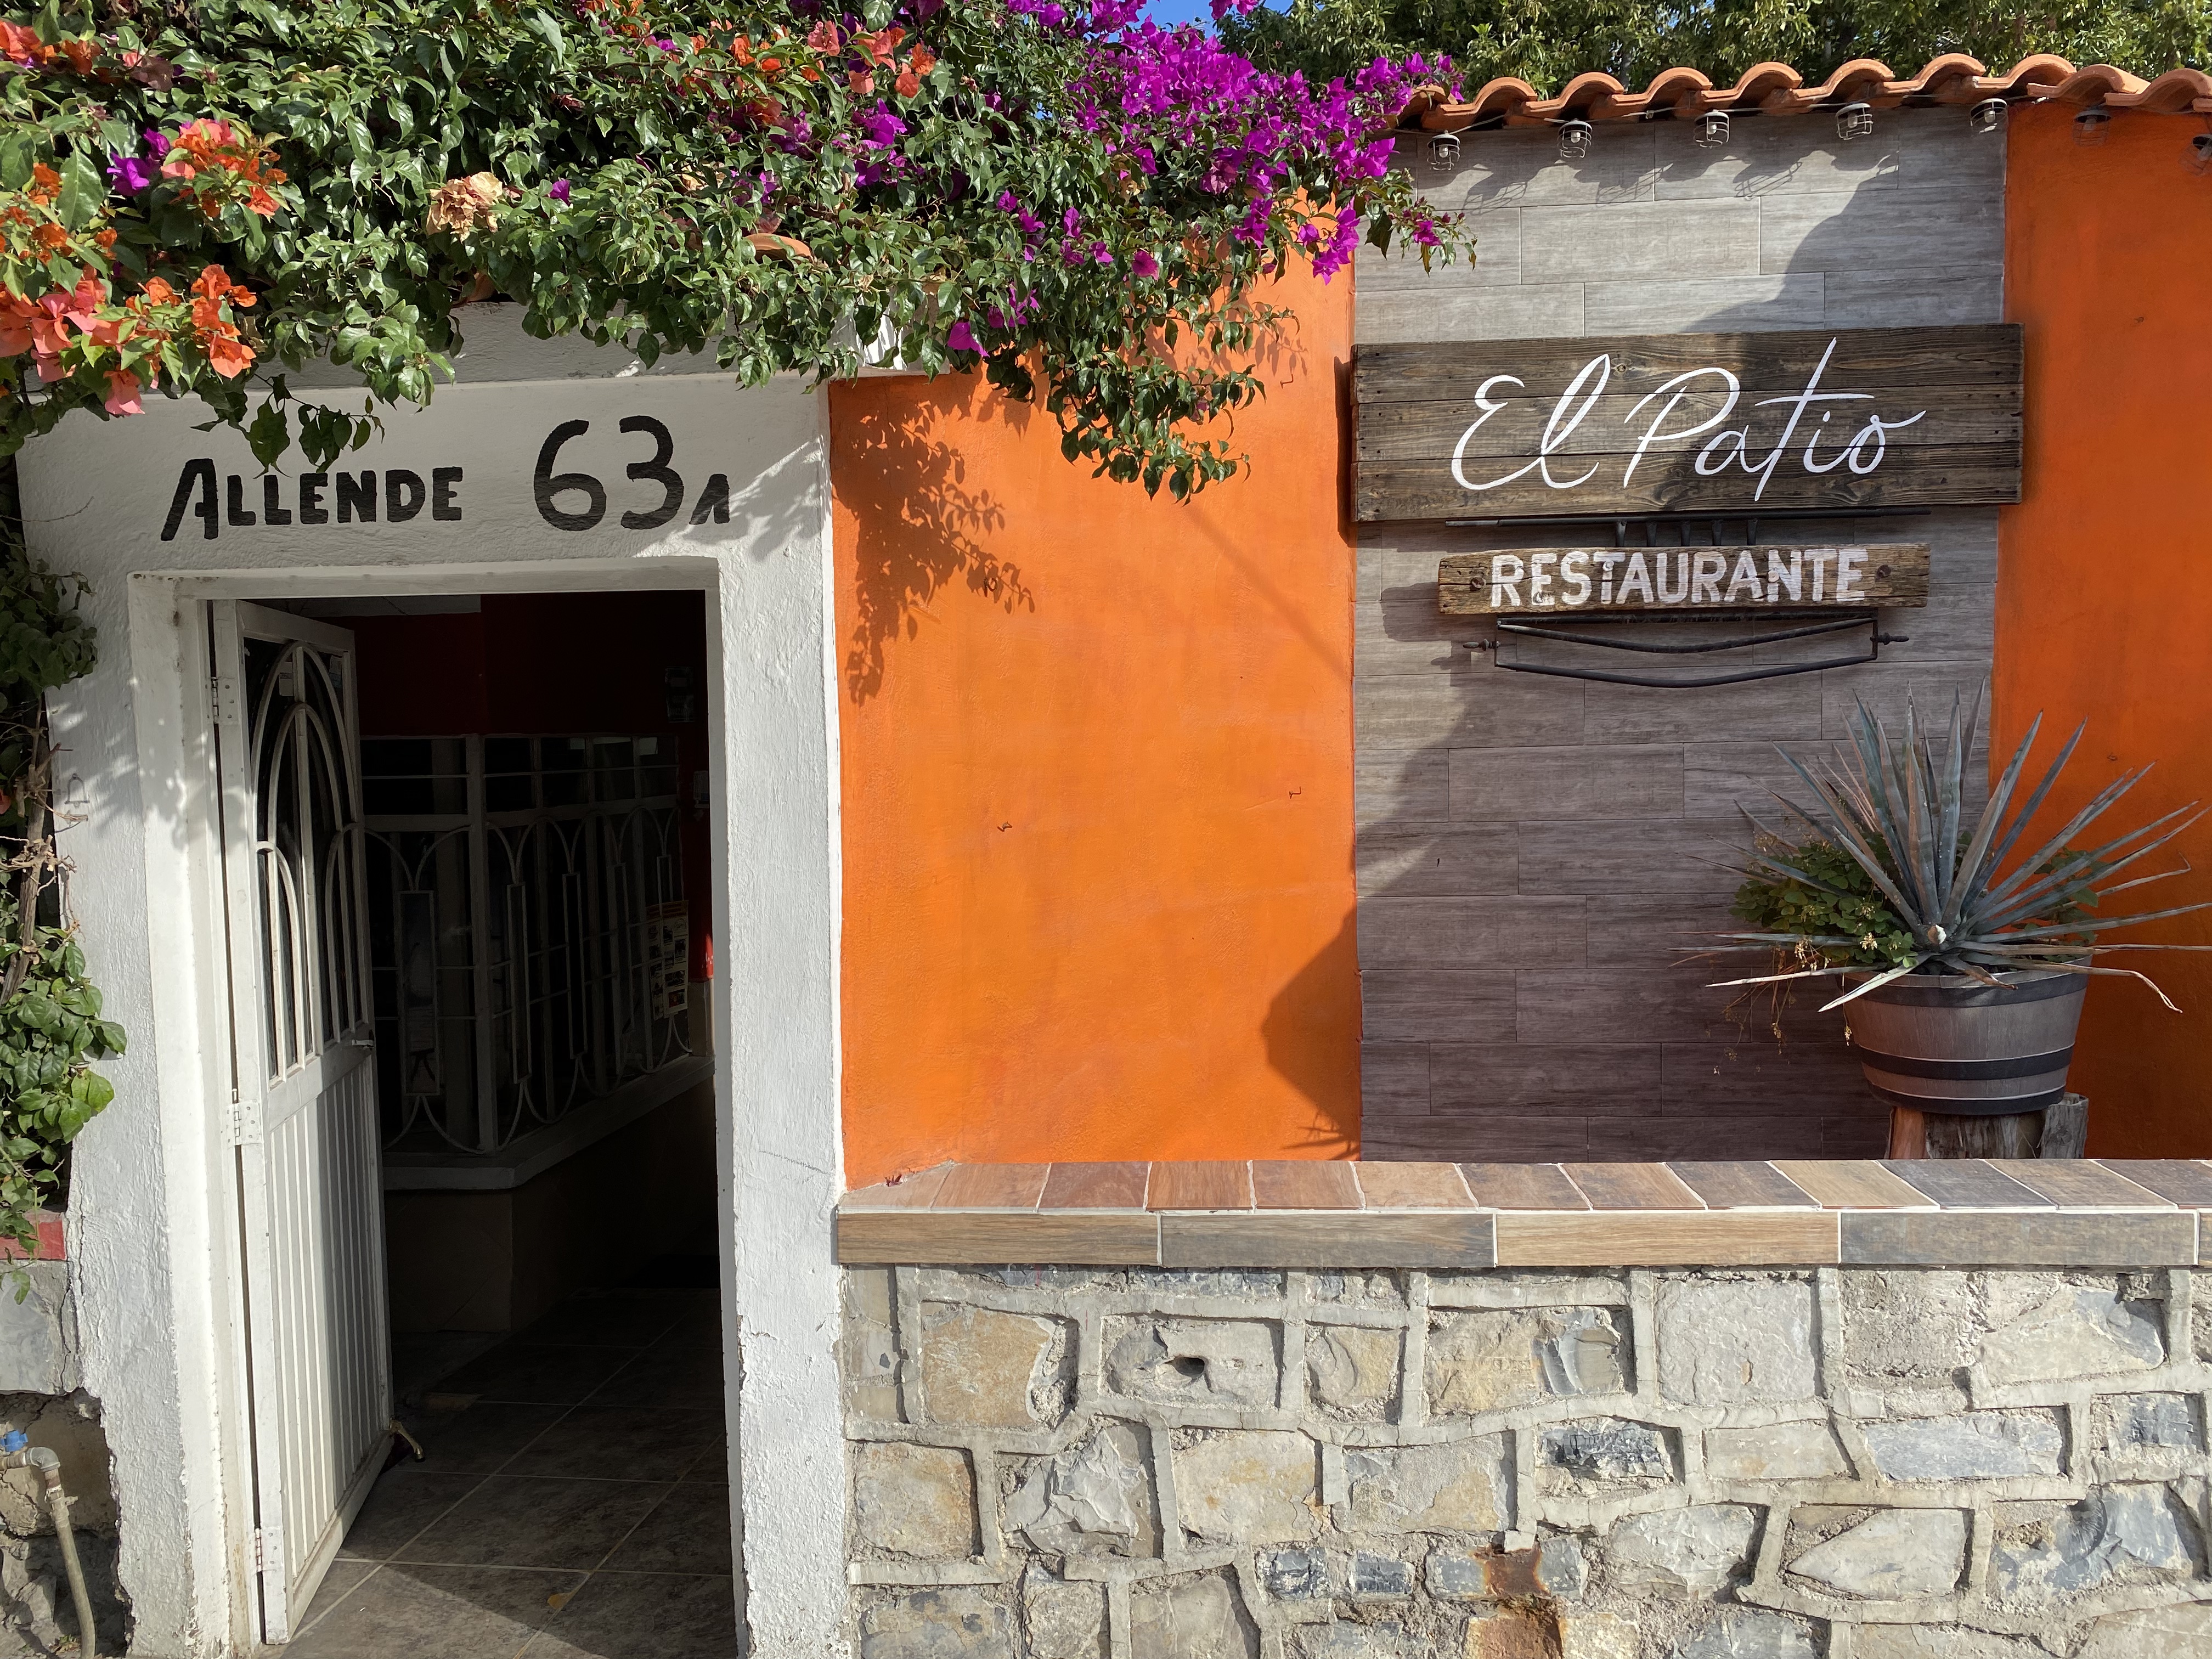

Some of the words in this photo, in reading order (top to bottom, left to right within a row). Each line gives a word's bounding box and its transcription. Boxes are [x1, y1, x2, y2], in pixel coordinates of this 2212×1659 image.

[1452, 353, 1611, 490] El
[1623, 337, 1926, 501] Patio
[160, 458, 464, 541] ALLENDE
[1489, 548, 1870, 609] RESTAURANTE
